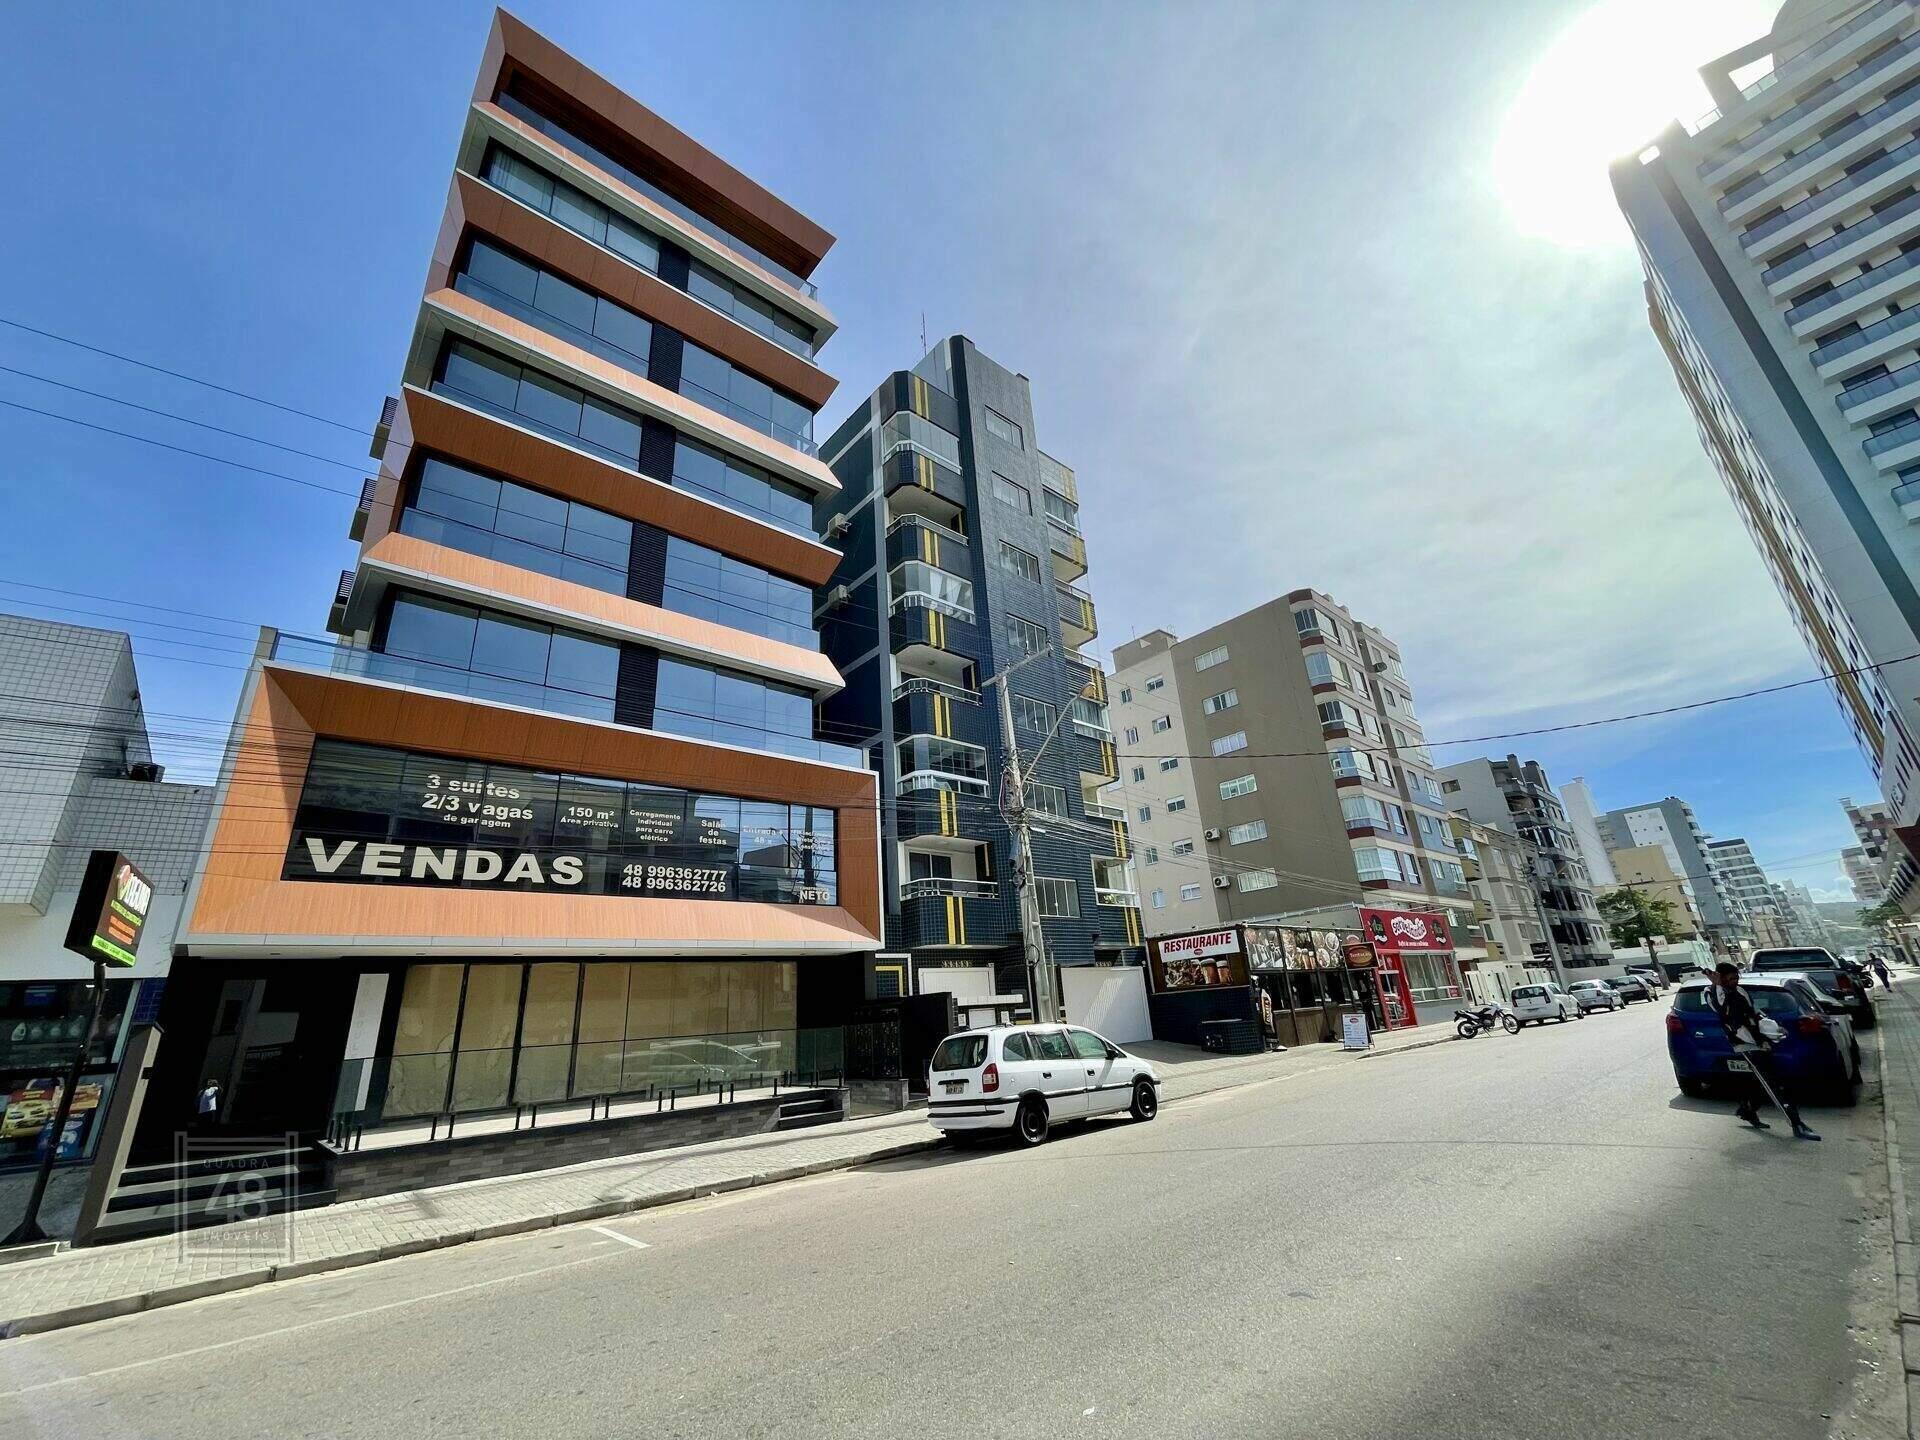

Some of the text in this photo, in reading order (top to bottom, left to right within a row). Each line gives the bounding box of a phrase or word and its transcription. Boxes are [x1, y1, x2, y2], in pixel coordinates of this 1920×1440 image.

[426, 774, 441, 789] 3
[421, 793, 533, 820] 2/3 vagas
[568, 807, 615, 820] 150 m²
[443, 814, 511, 828] de garagem
[629, 809, 681, 820] Carregamento
[560, 816, 619, 829] Área privativa
[635, 825, 674, 835] para carro
[640, 834, 669, 843] elétrico
[699, 835, 727, 846] festas
[305, 838, 583, 885] VENDAS
[623, 863, 727, 881] 48 996362777
[622, 875, 727, 893] 48 996362726
[1163, 932, 1232, 954] RESTAURANTE
